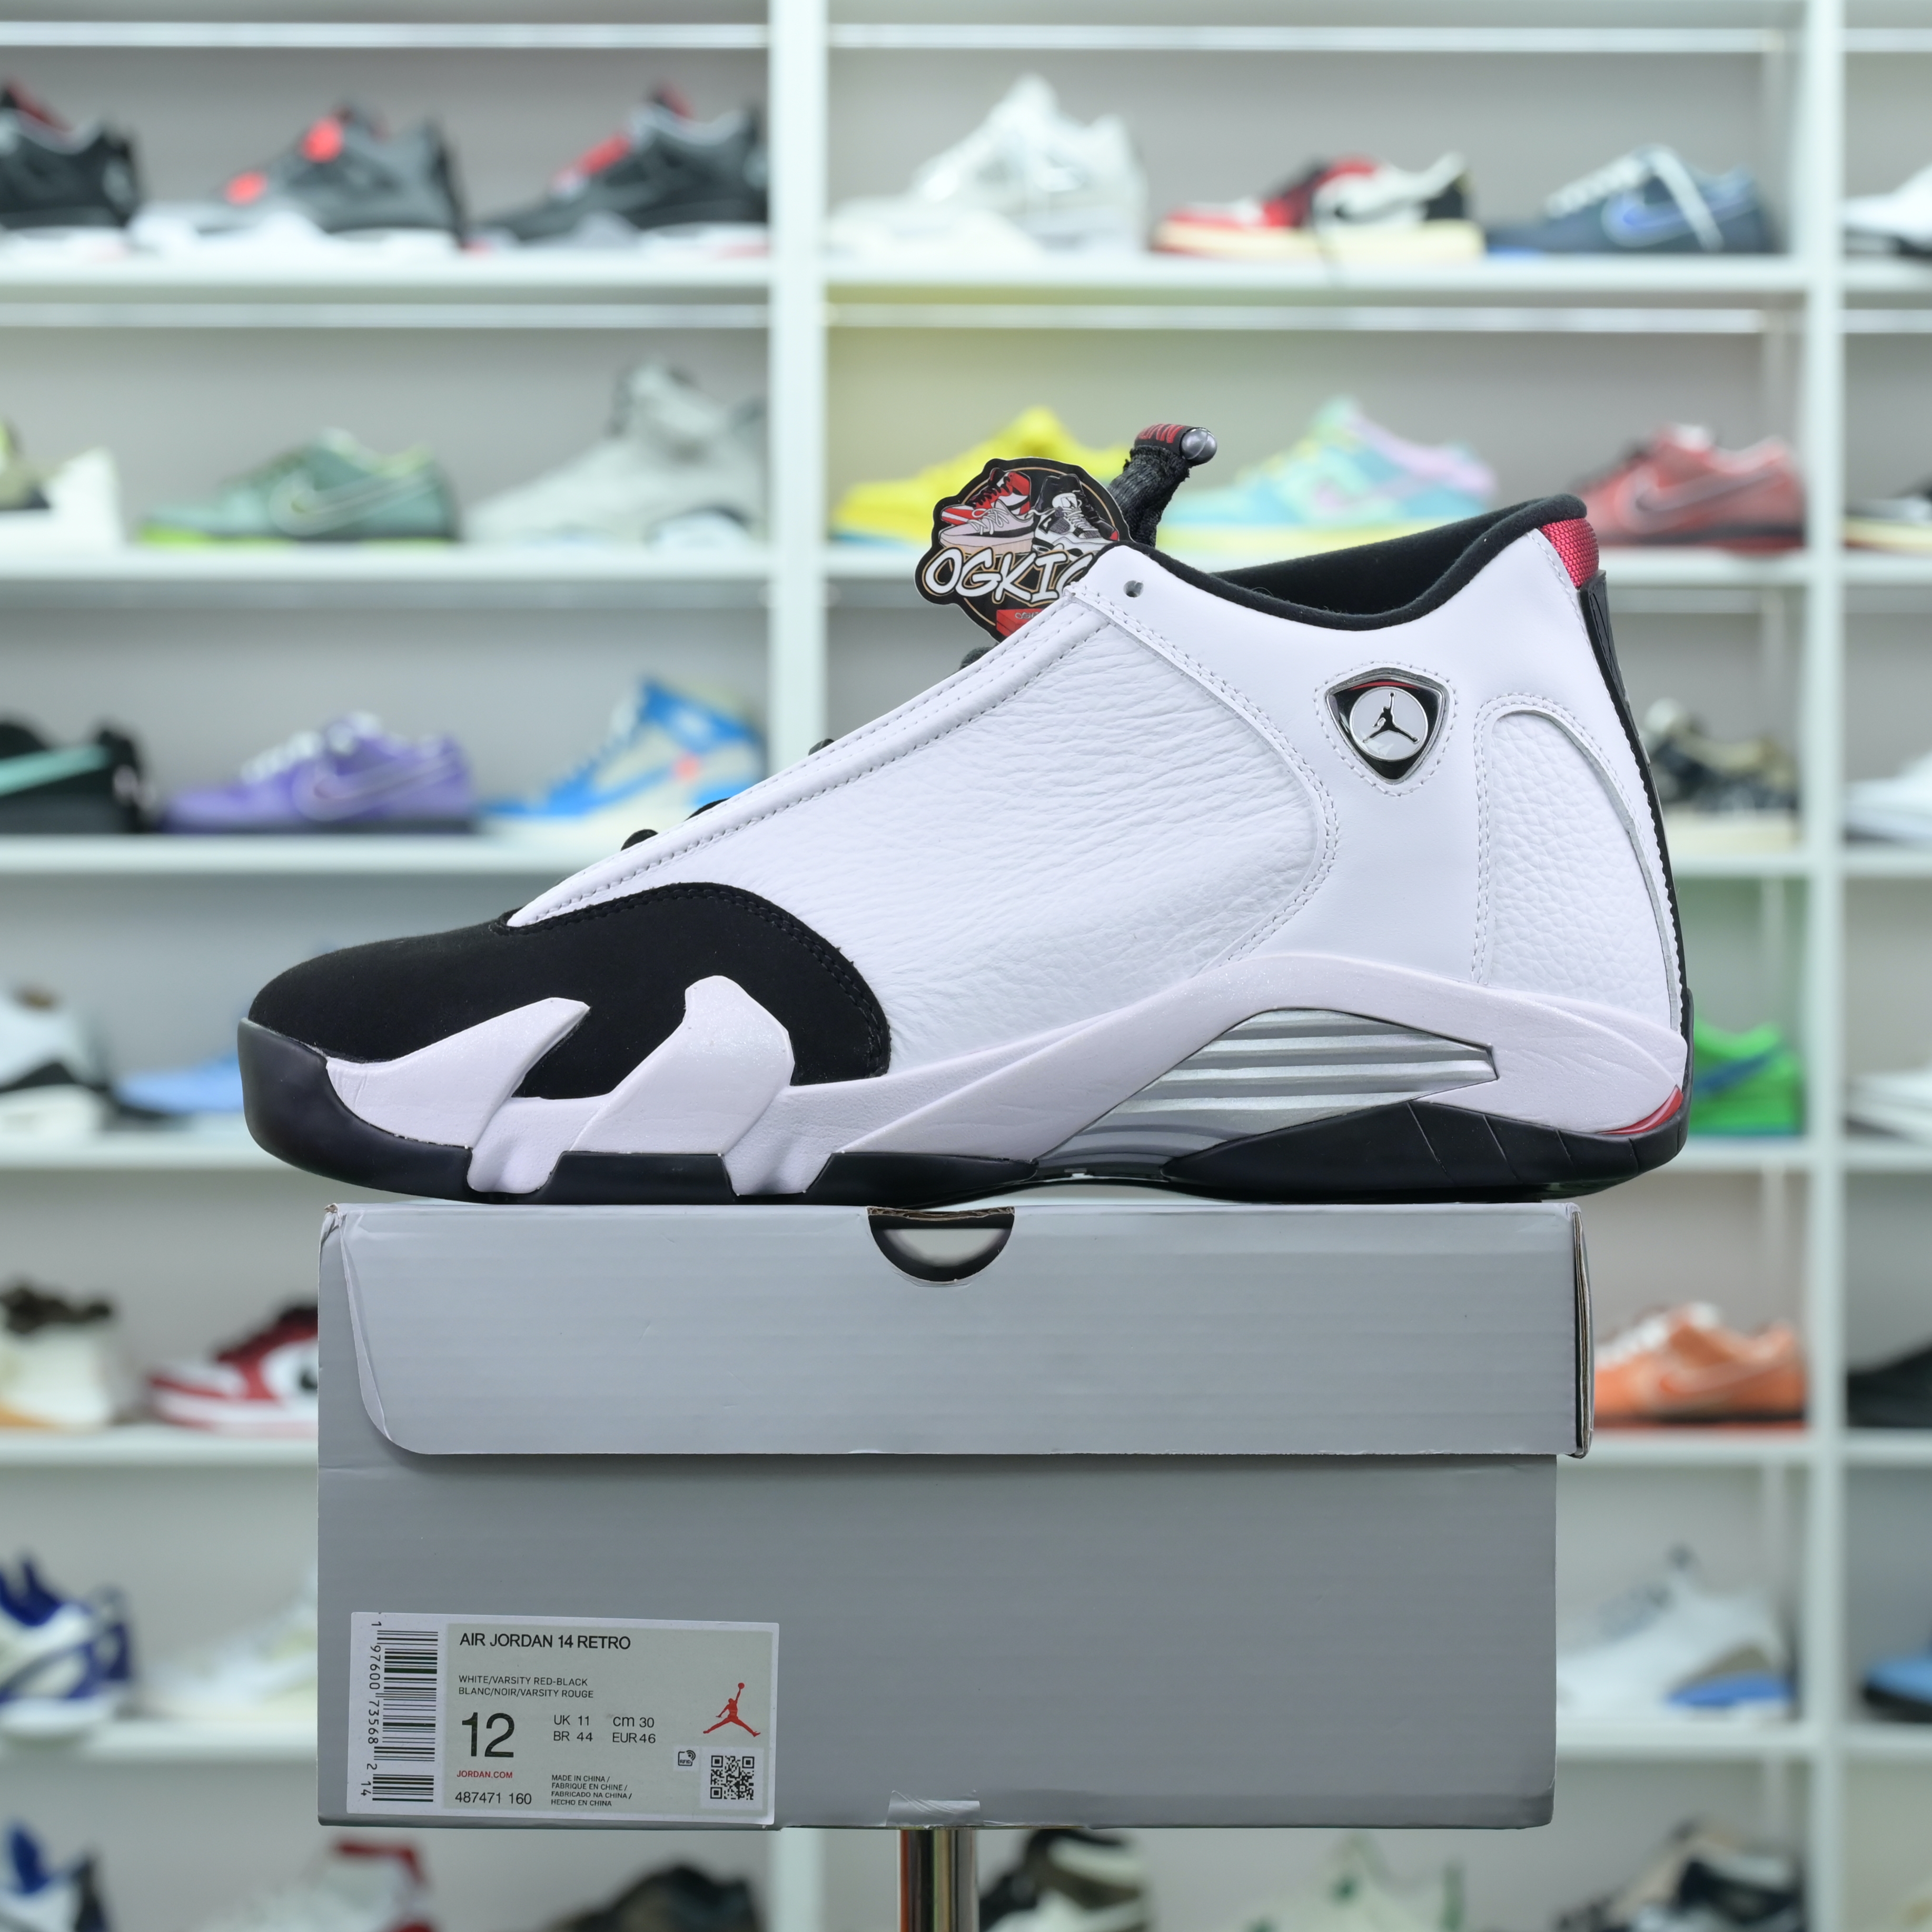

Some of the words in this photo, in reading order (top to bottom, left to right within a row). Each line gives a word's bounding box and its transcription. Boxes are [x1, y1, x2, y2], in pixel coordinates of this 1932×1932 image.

[459, 1632, 486, 1646] AIR
[490, 1633, 553, 1648] JORDAN
[558, 1634, 574, 1648] 14
[577, 1635, 631, 1650] RETRO
[369, 1645, 381, 1690] 97600
[459, 1675, 531, 1685] WHITE/VARSITY
[534, 1677, 588, 1686] RED-BLACK
[459, 1687, 559, 1697] BLANC/NOIR/VARSITY
[561, 1690, 593, 1698] ROUGE
[368, 1700, 380, 1744] 73568
[554, 1715, 570, 1725] UK
[578, 1715, 589, 1726] 11
[639, 1717, 655, 1728] 30
[462, 1712, 515, 1758] 12
[553, 1730, 570, 1741] BR
[577, 1732, 593, 1742] 44
[612, 1732, 637, 1743] EUR
[639, 1733, 656, 1743] 46
[360, 1781, 372, 1796] 14
[455, 1791, 501, 1804] 487471
[509, 1792, 532, 1805] 160
